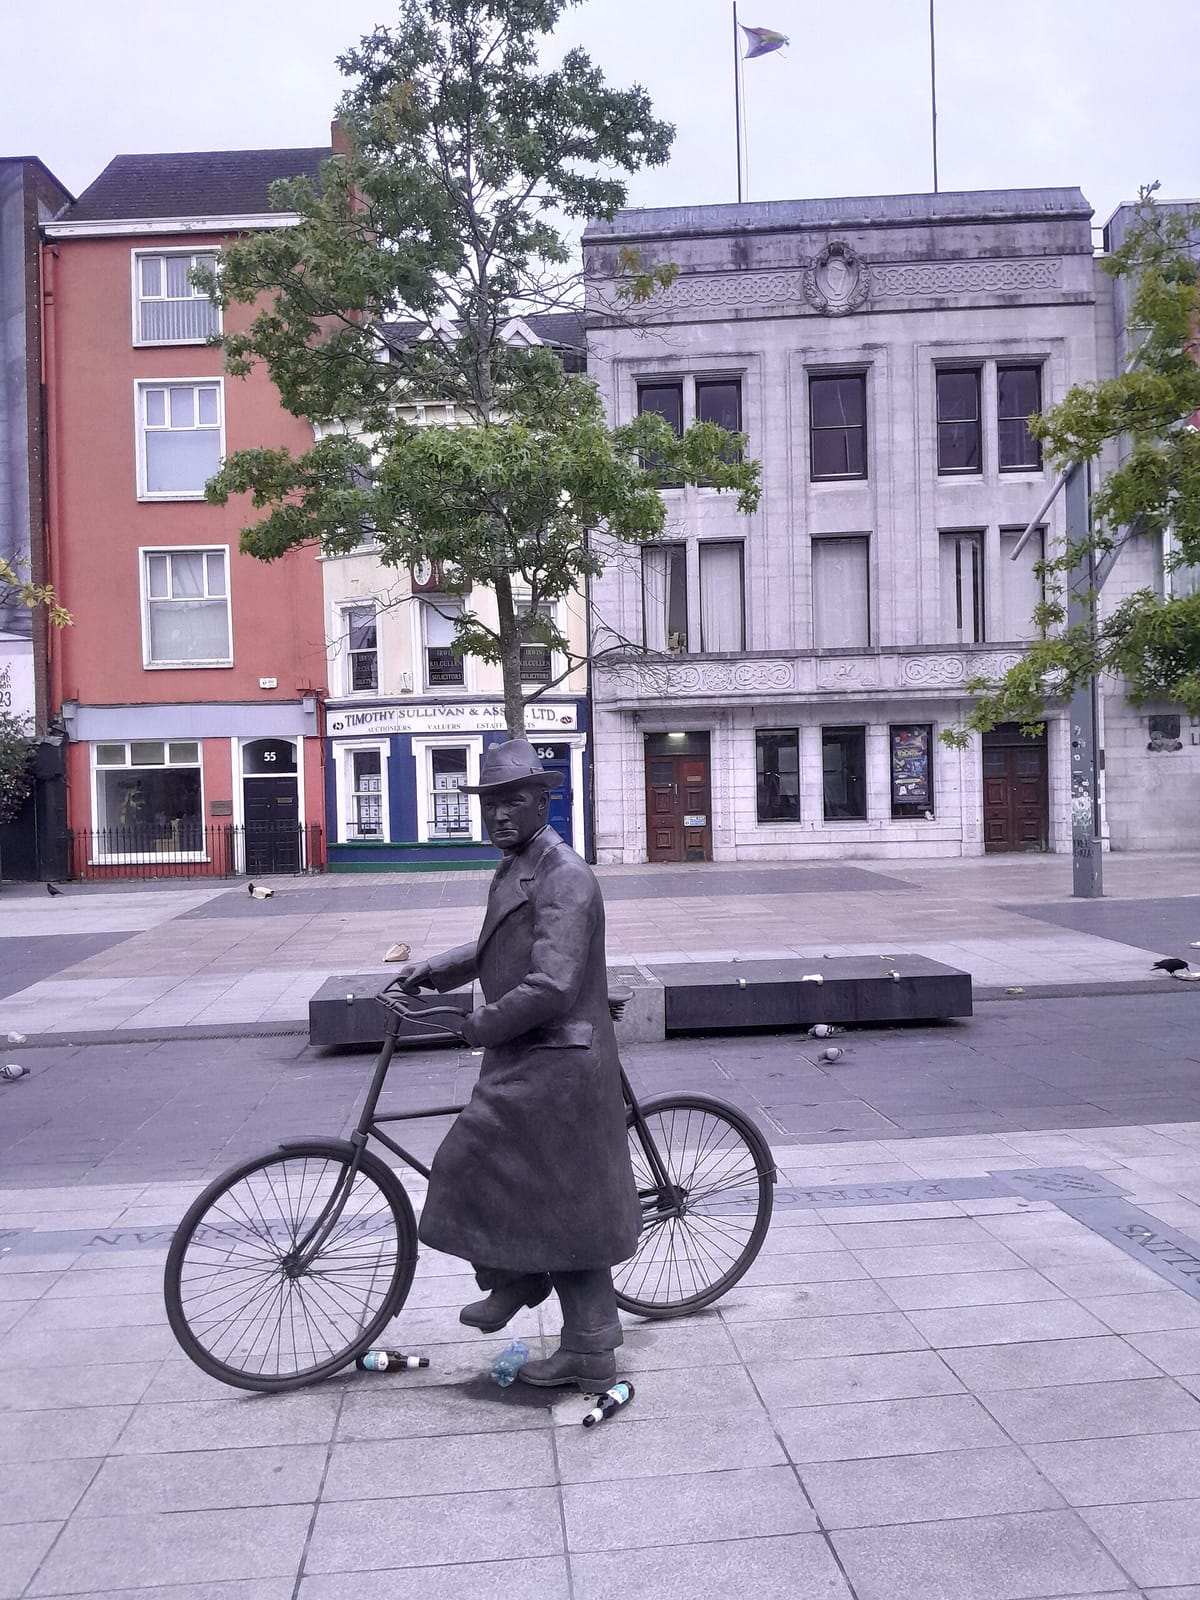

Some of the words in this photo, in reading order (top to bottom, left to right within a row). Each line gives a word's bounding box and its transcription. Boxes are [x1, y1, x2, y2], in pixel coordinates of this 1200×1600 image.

[345, 710, 395, 728] TIMOTHY
[399, 707, 464, 718] SULLIVAN
[469, 707, 479, 717] &
[532, 708, 558, 722] LTD.
[264, 751, 277, 762] 55
[537, 747, 555, 759] 56
